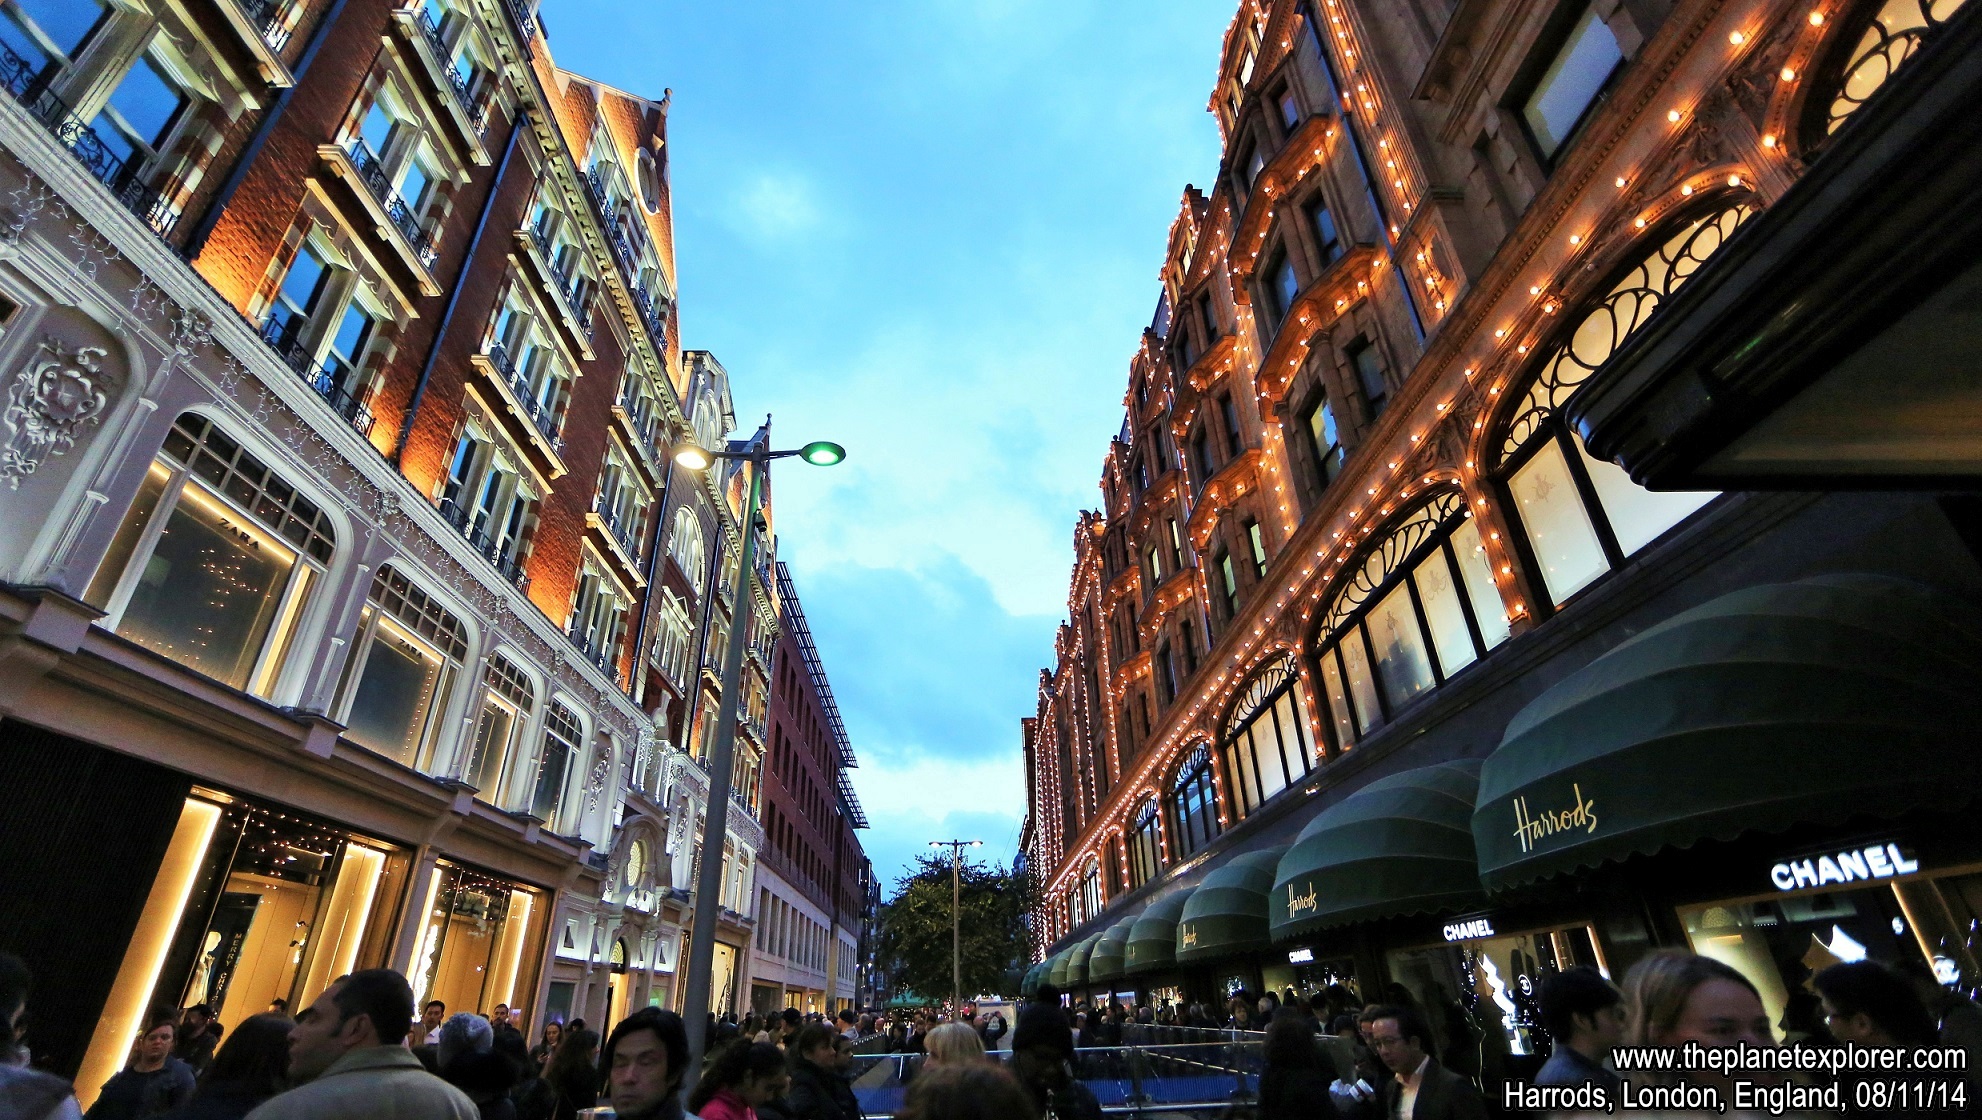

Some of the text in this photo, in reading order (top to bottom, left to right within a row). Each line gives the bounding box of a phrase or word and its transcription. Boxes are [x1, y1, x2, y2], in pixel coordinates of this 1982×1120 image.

[218, 517, 259, 550] ZARA
[399, 638, 422, 659] ZARA
[1512, 783, 1597, 853] Harrods
[1770, 842, 1919, 891] CHANEL
[1287, 881, 1317, 919] Harrods
[1443, 919, 1495, 942] CHANEL
[226, 933, 243, 967] MERRY
